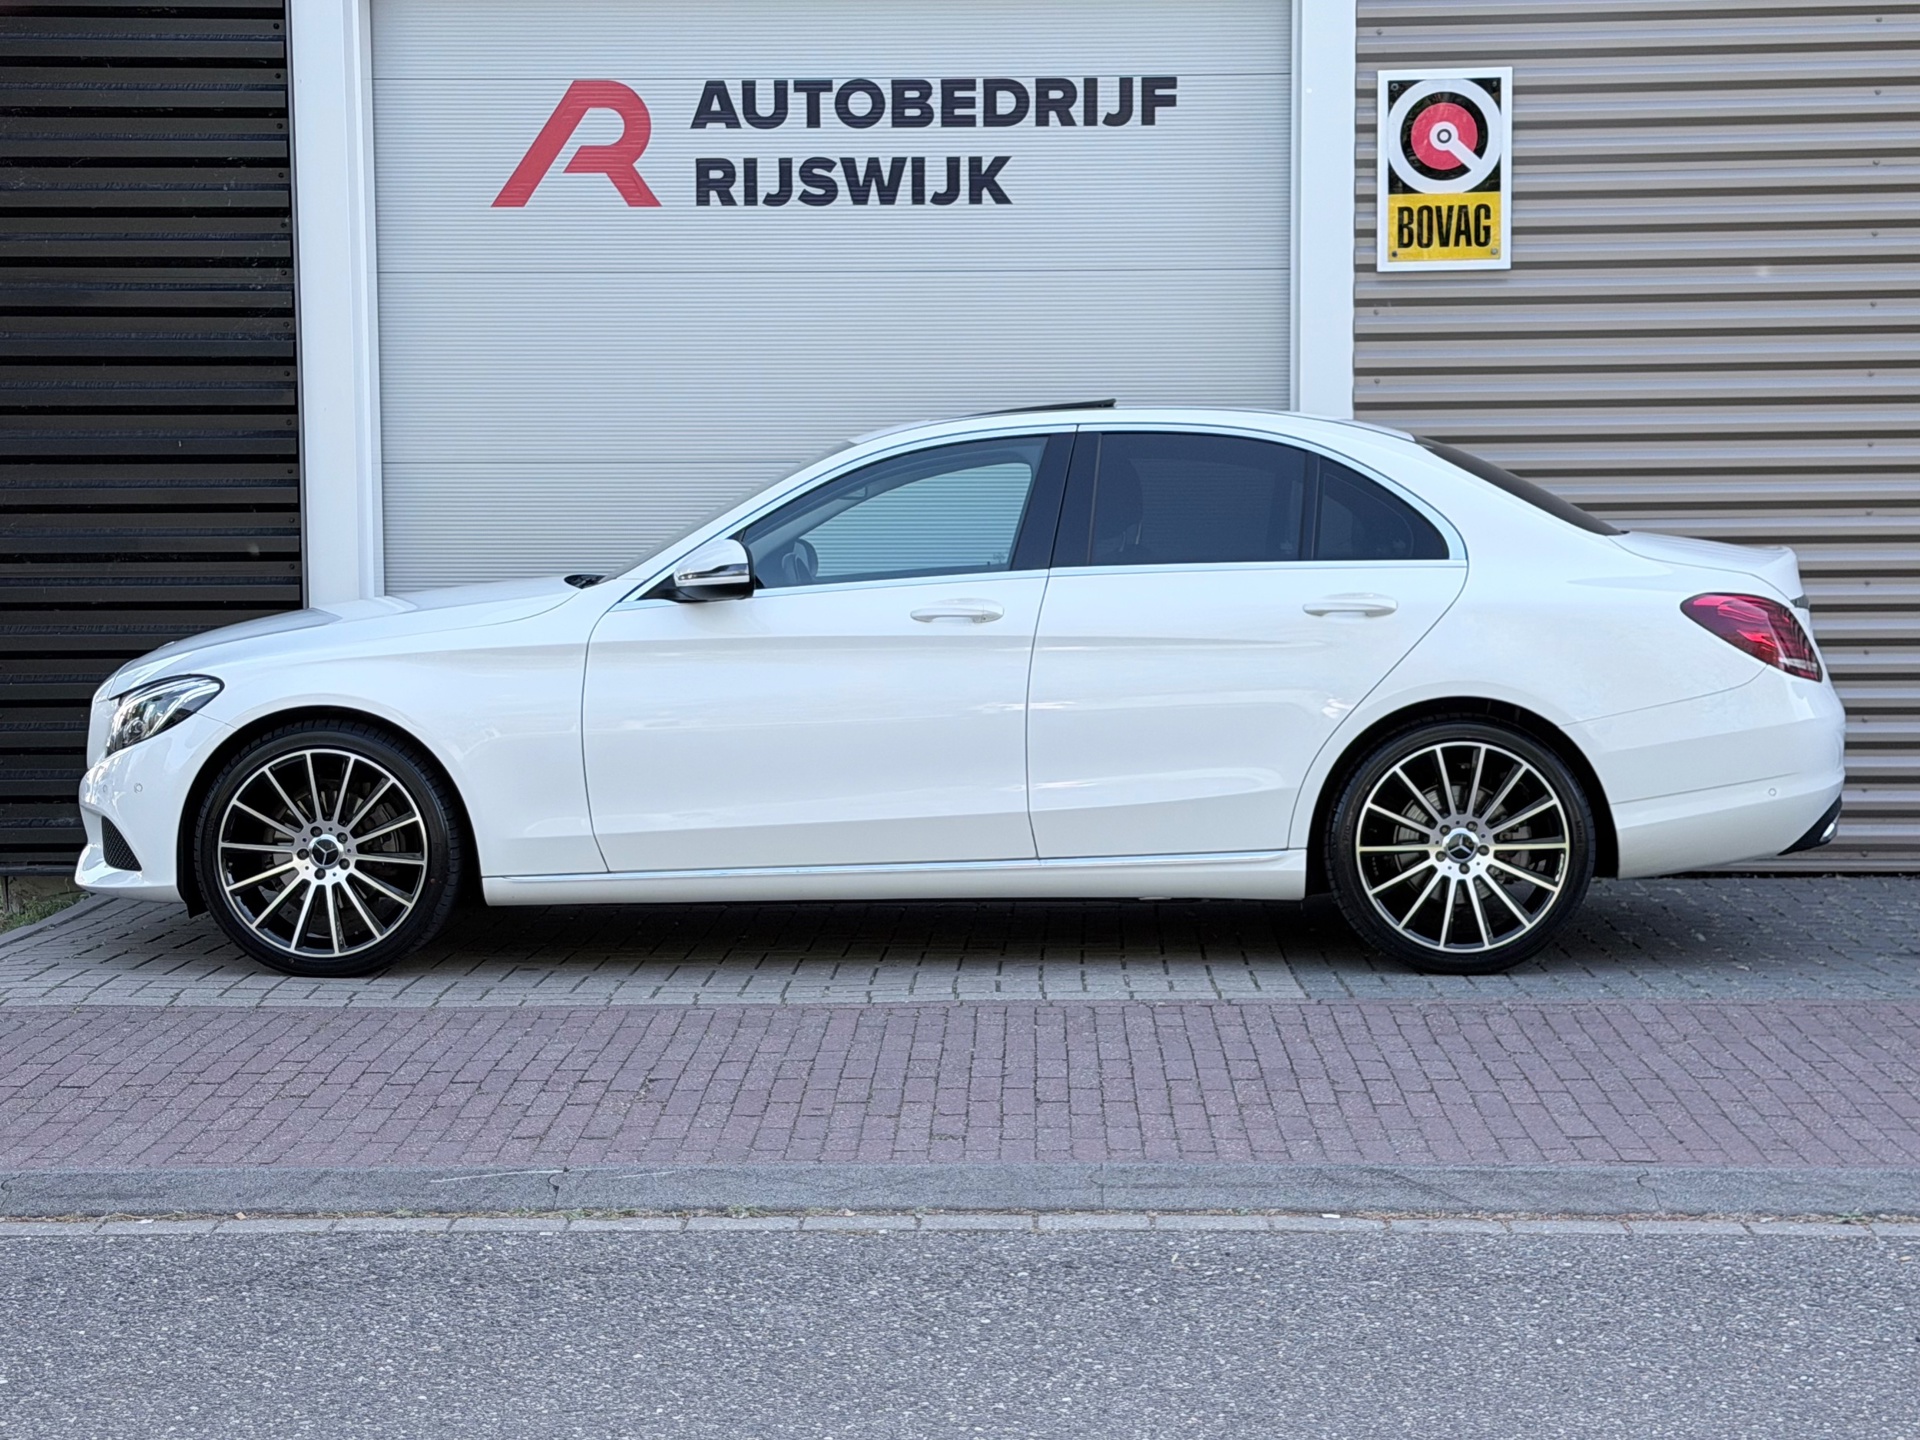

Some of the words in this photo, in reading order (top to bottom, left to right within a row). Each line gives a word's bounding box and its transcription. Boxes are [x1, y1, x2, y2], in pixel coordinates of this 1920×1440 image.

[691, 77, 1177, 129] AUTOBEDRIJF
[696, 156, 1012, 206] RIJSWIJK
[1398, 204, 1490, 248] BOVAG
